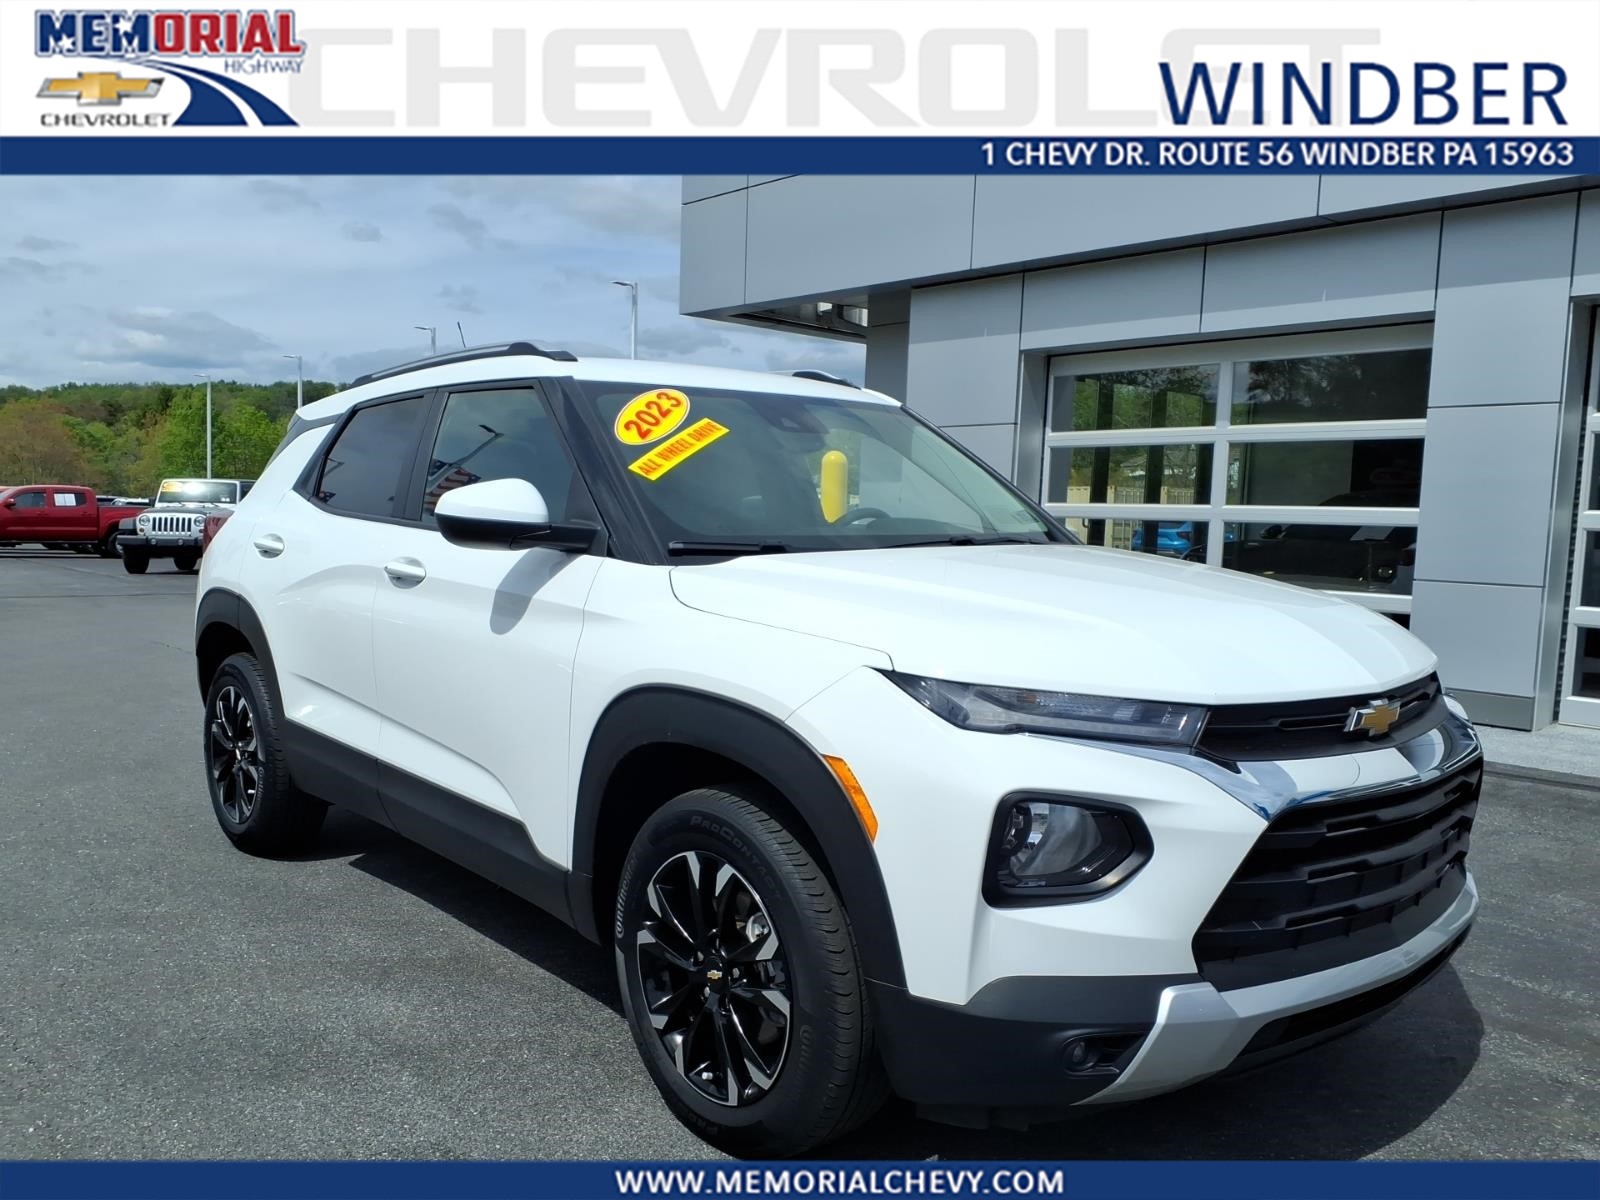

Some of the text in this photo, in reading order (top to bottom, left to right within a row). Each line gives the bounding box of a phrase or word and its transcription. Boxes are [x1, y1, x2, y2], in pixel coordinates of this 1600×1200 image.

[624, 391, 682, 440] 2023
[636, 420, 722, 476] ALL WHEEL DRIVE
